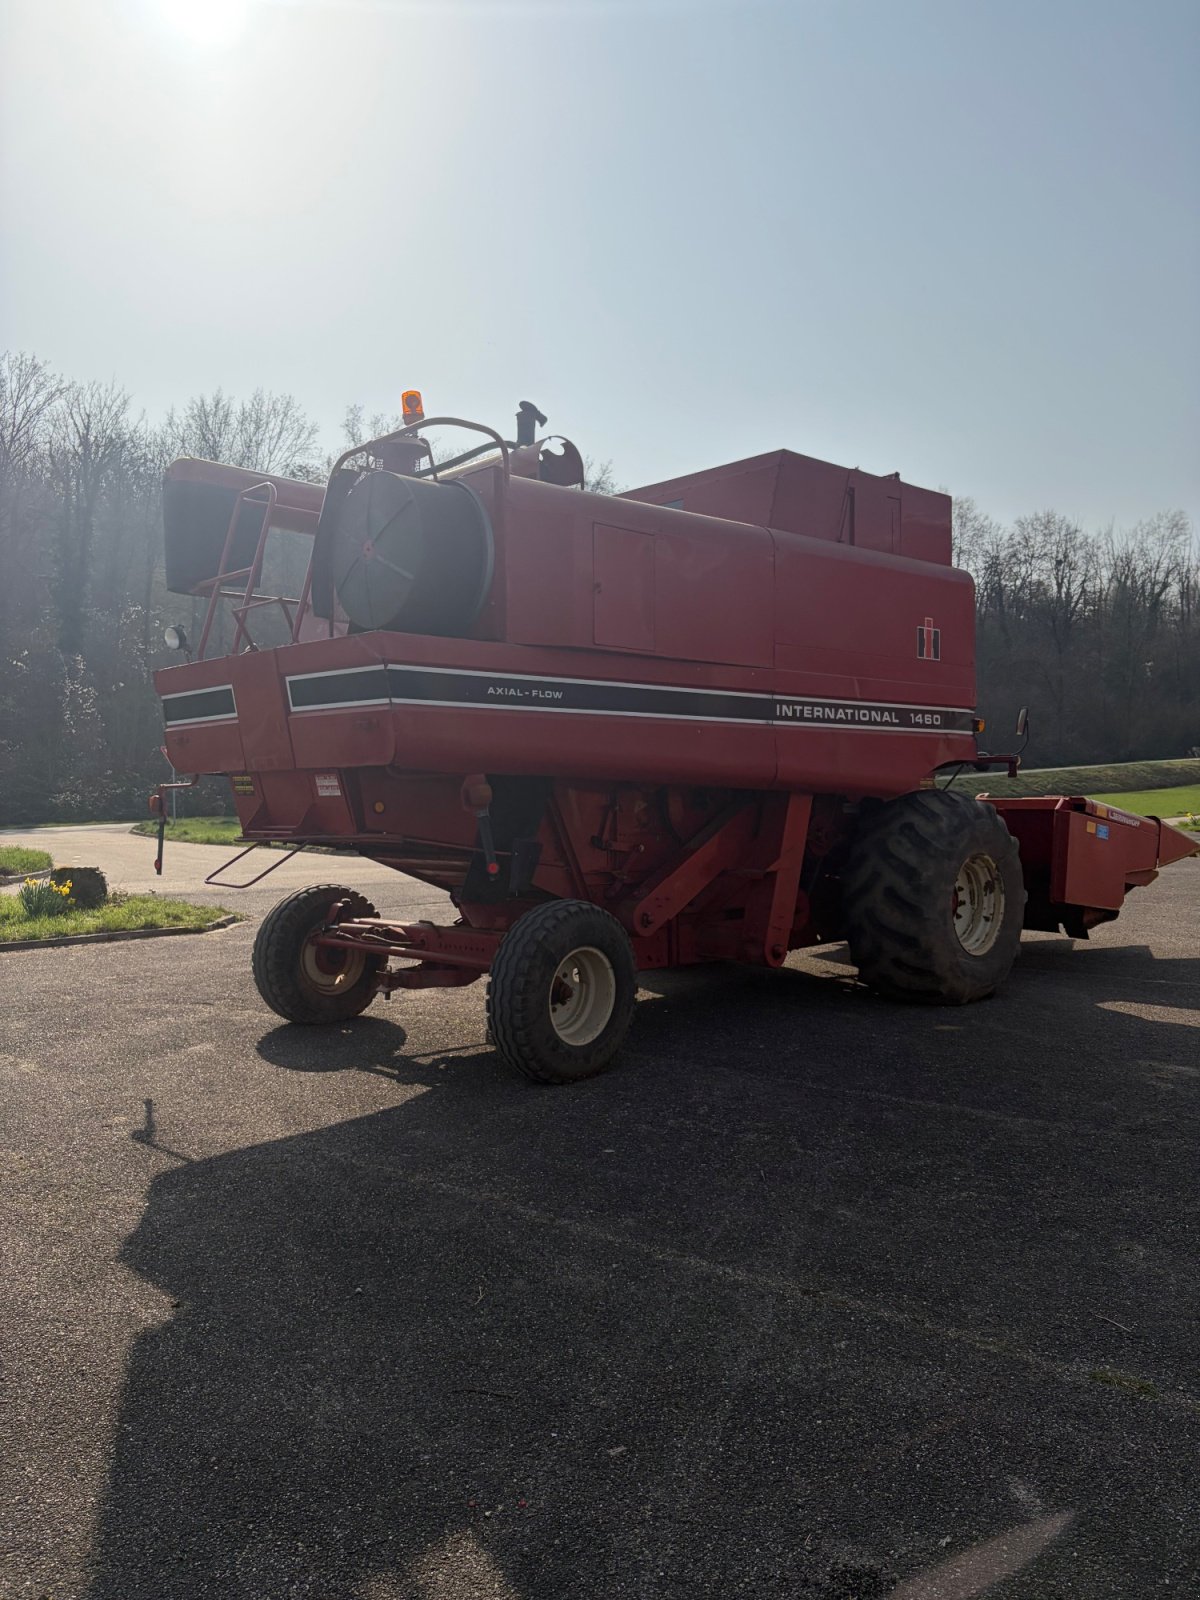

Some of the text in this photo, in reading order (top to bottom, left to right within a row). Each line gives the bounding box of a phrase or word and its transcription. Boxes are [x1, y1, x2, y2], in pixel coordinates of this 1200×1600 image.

[487, 686, 563, 699] AXIAL-FLOW
[776, 704, 941, 725] INTERNATIONAL 1460
